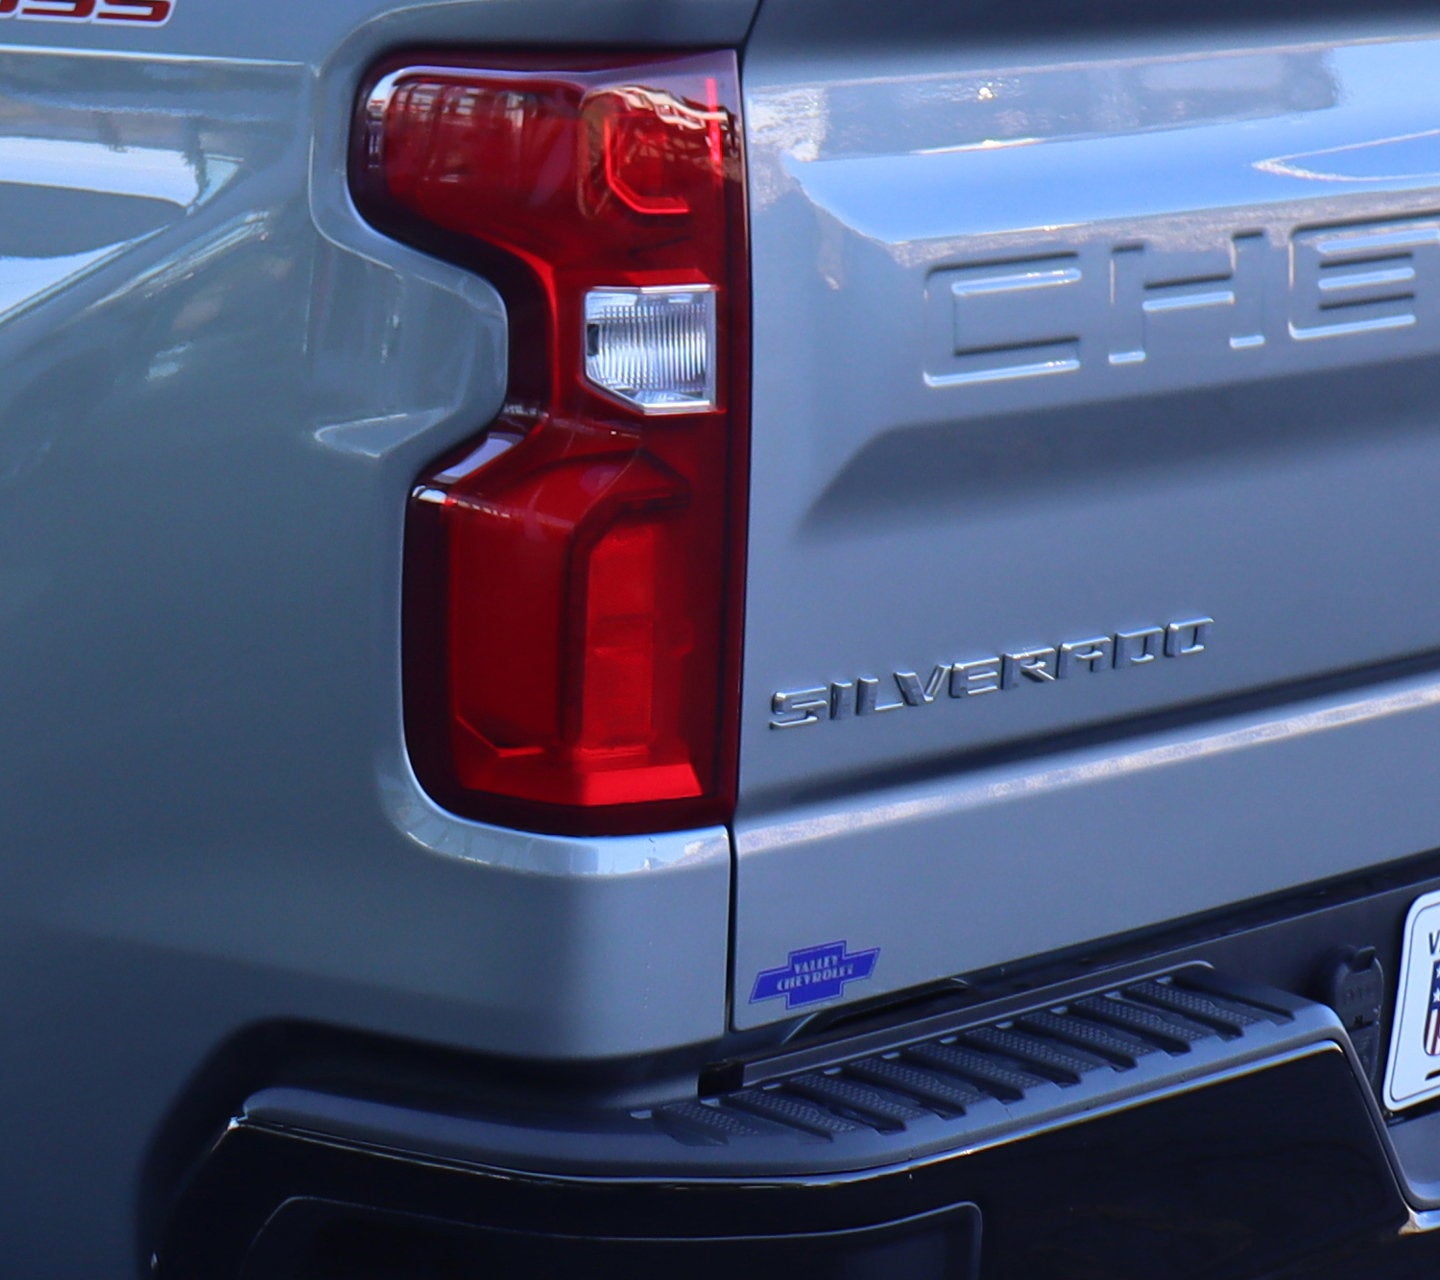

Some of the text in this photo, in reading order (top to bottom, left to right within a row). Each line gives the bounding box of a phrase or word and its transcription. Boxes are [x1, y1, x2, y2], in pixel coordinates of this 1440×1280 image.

[769, 616, 1215, 730] SILVERADO
[777, 963, 855, 991] CHEVROLET
[793, 955, 838, 974] VALLEY
